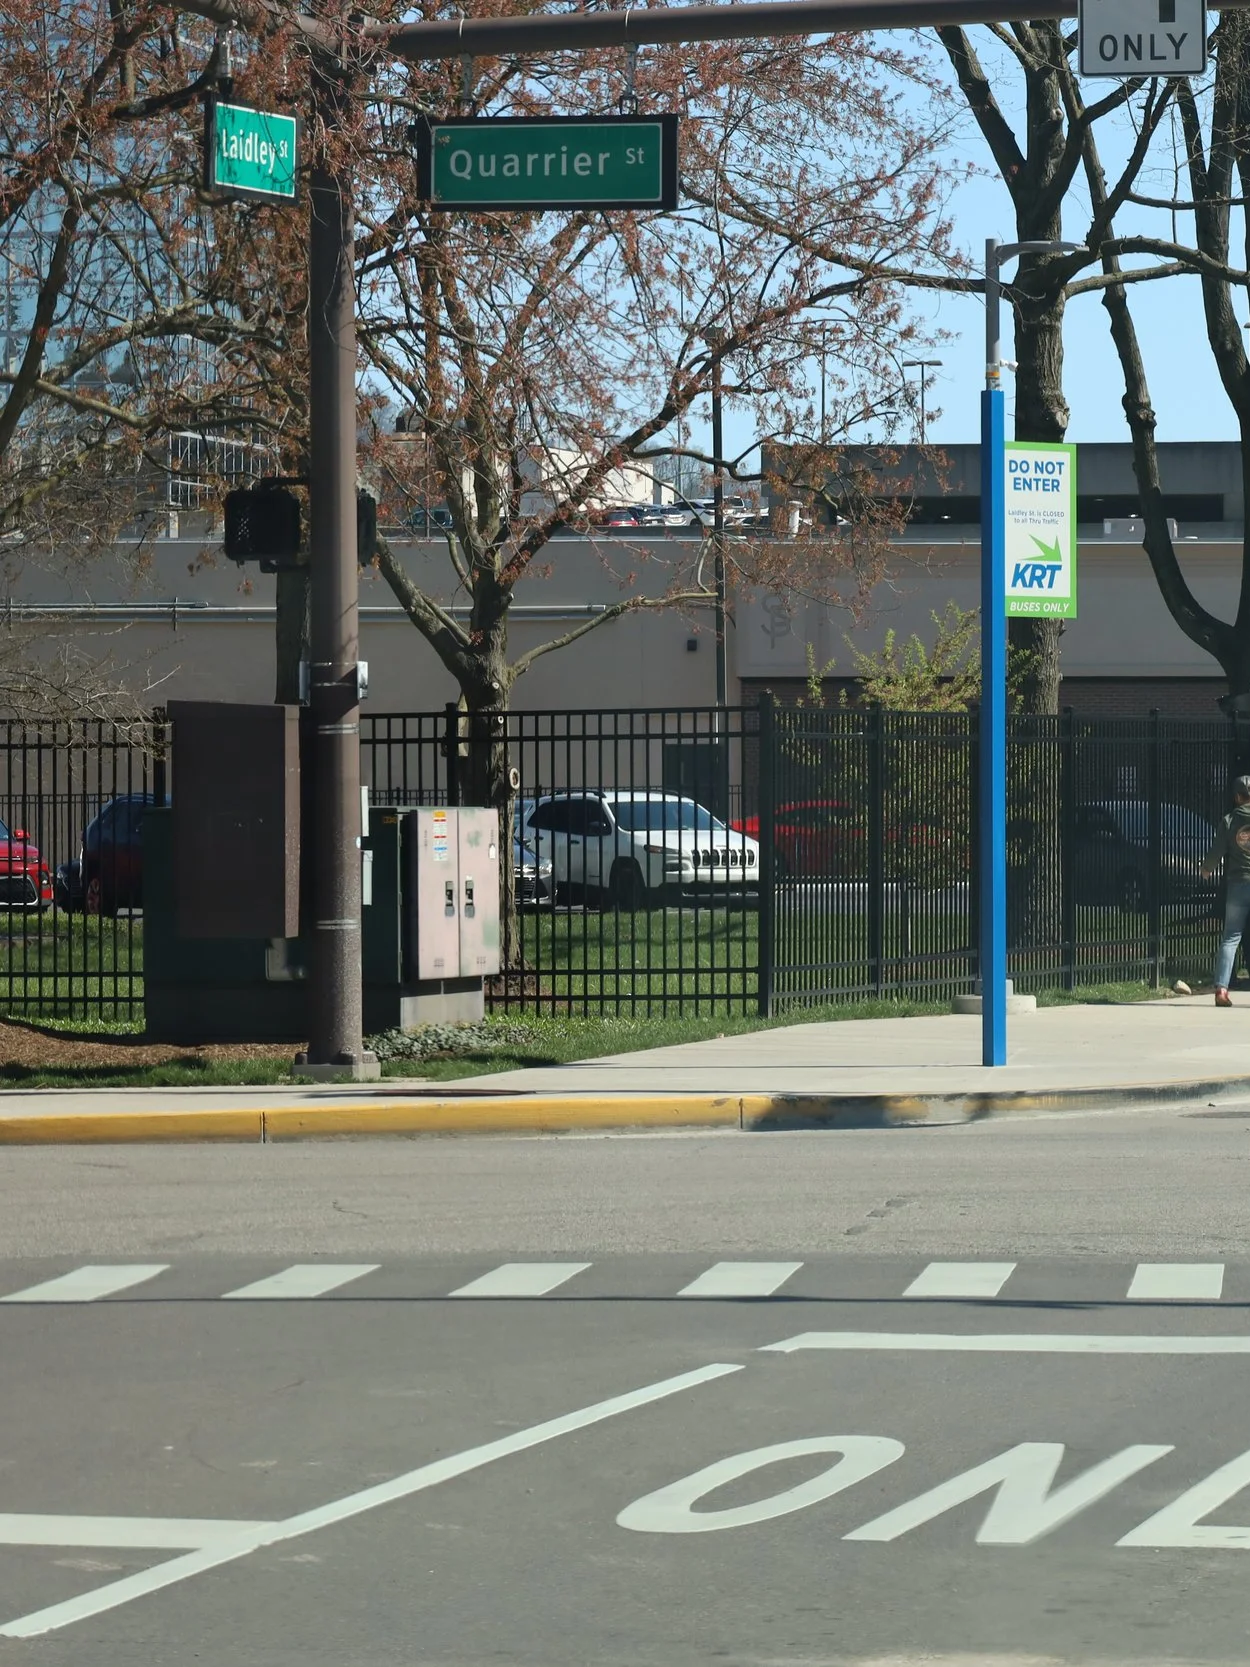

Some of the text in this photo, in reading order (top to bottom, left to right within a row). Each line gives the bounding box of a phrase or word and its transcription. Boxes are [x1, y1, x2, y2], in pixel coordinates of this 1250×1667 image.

[1099, 32, 1188, 62] ONLY
[221, 127, 289, 174] Laidley St
[449, 145, 645, 181] Quarrier St
[1009, 460, 1065, 476] DO NOT
[1013, 477, 1060, 492] ENTER
[1011, 563, 1062, 588] KRT
[1010, 602, 1070, 613] BUSES ONLY
